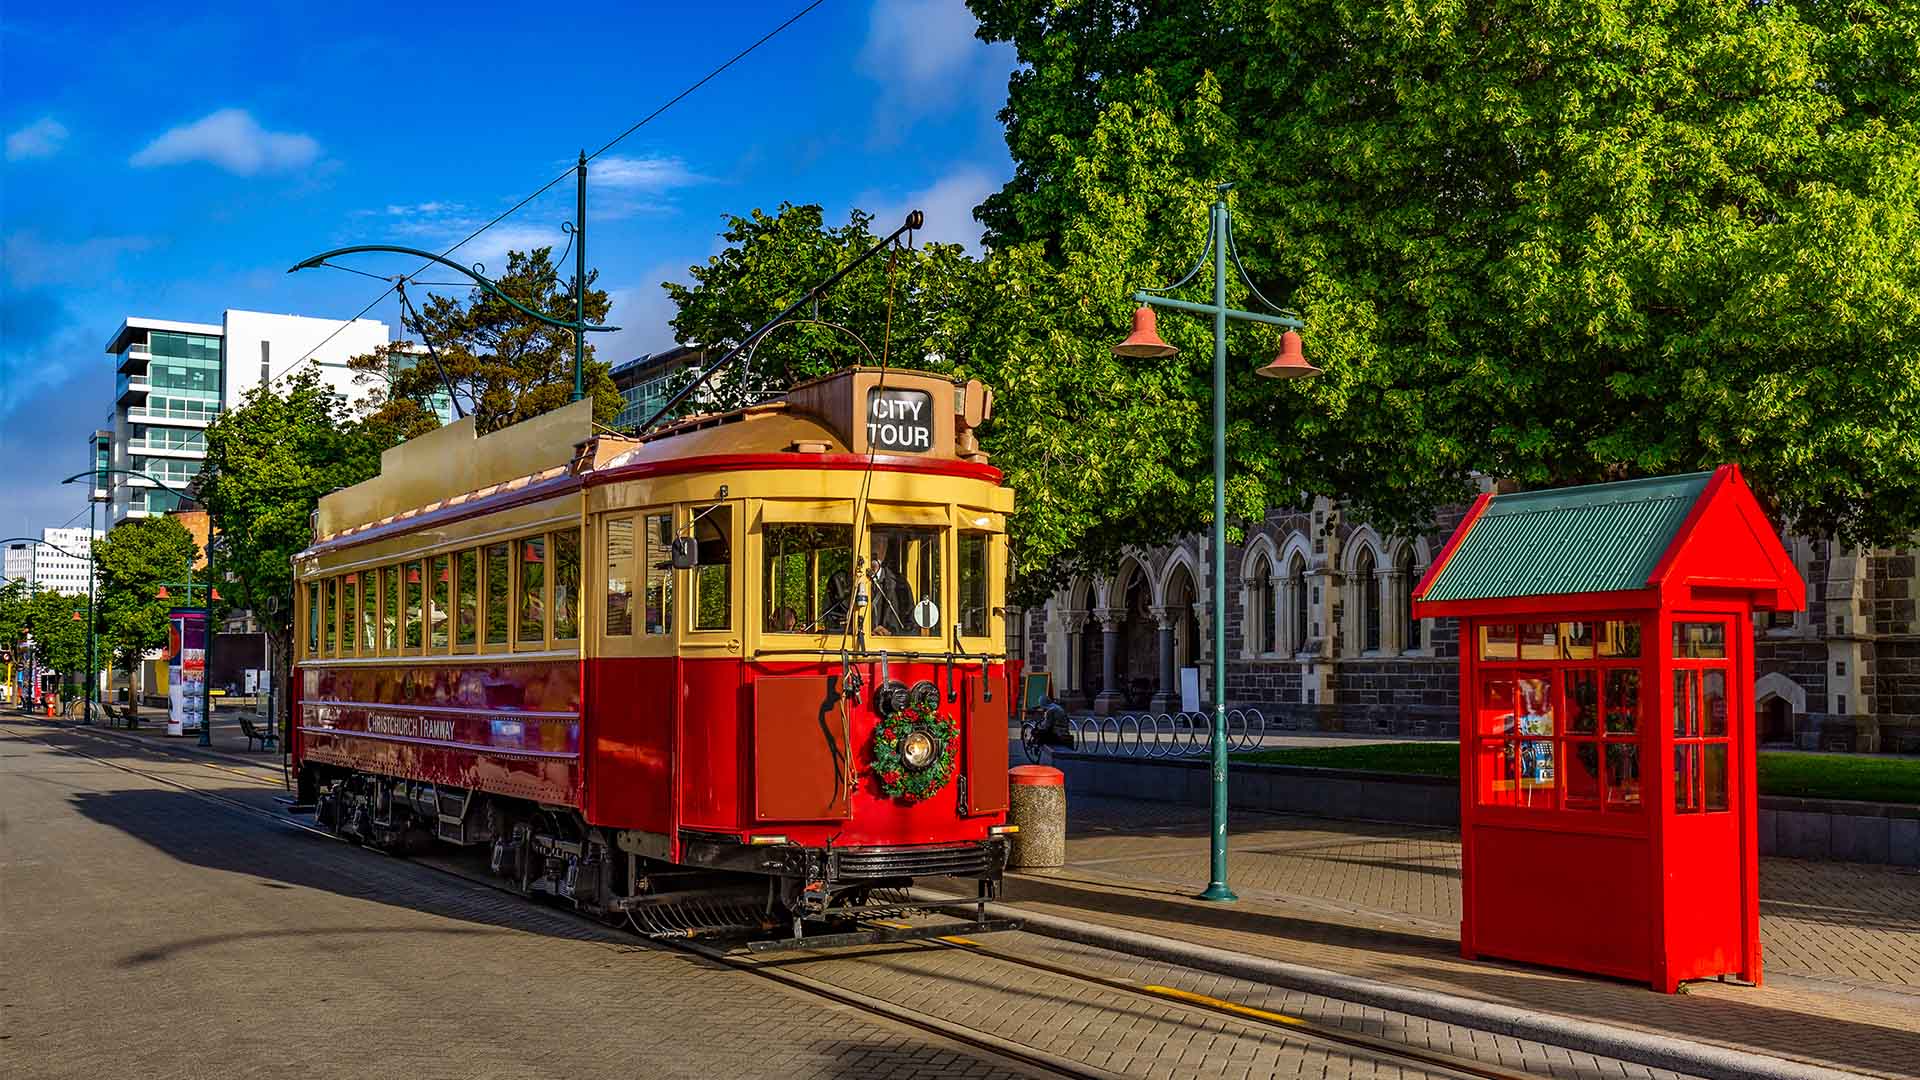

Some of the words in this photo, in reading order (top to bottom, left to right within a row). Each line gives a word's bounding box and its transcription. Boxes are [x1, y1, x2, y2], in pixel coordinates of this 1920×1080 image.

[872, 398, 923, 421] CITY
[866, 423, 929, 447] TOUR
[367, 712, 418, 737] CHRISTCHURCH
[419, 716, 455, 740] TRAMWAY
